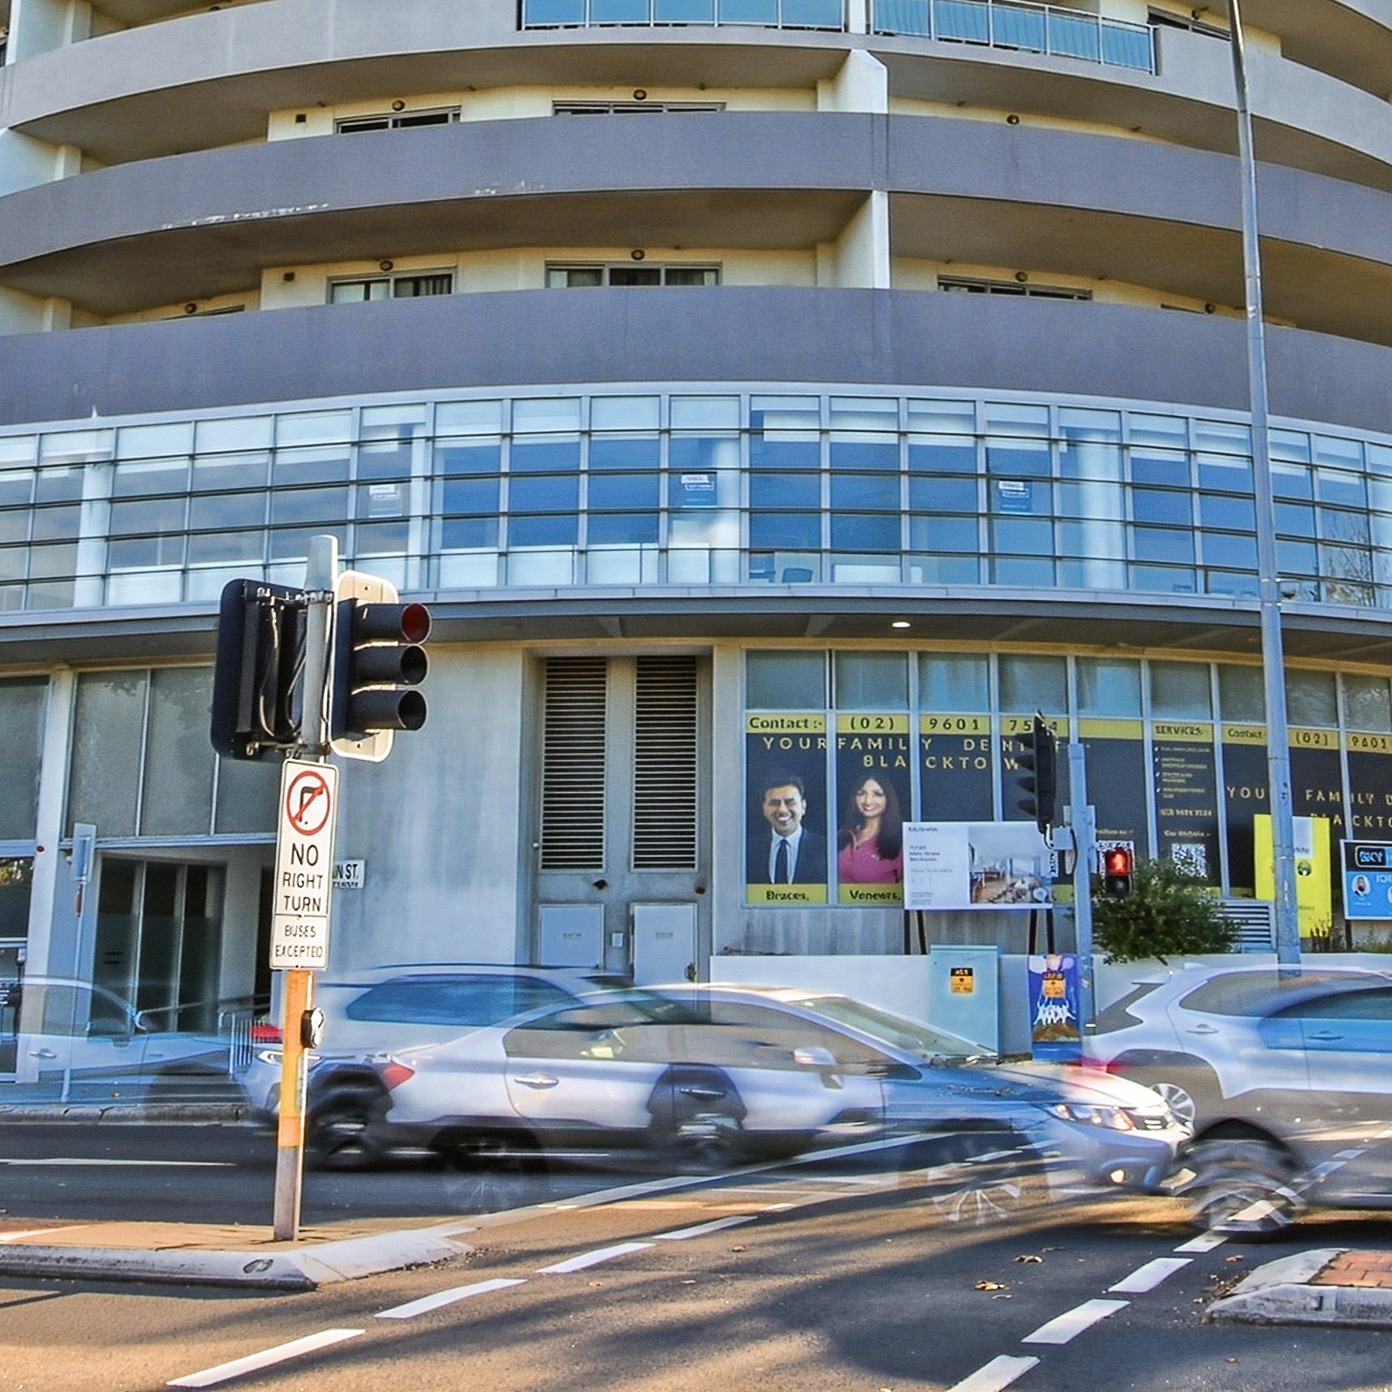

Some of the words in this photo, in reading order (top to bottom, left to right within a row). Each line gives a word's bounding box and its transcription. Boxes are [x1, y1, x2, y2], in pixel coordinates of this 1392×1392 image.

[749, 717, 809, 729] Contact
[763, 737, 827, 750] YOUR
[838, 737, 932, 751] FAMILY
[863, 755, 1020, 770] BLACKTOW
[1226, 787, 1266, 800] YOU
[290, 842, 320, 867] NO
[282, 871, 324, 890] RIGHT
[283, 895, 322, 912] TURN
[284, 924, 317, 938] BUSES
[275, 944, 324, 958] EXCEPTED
